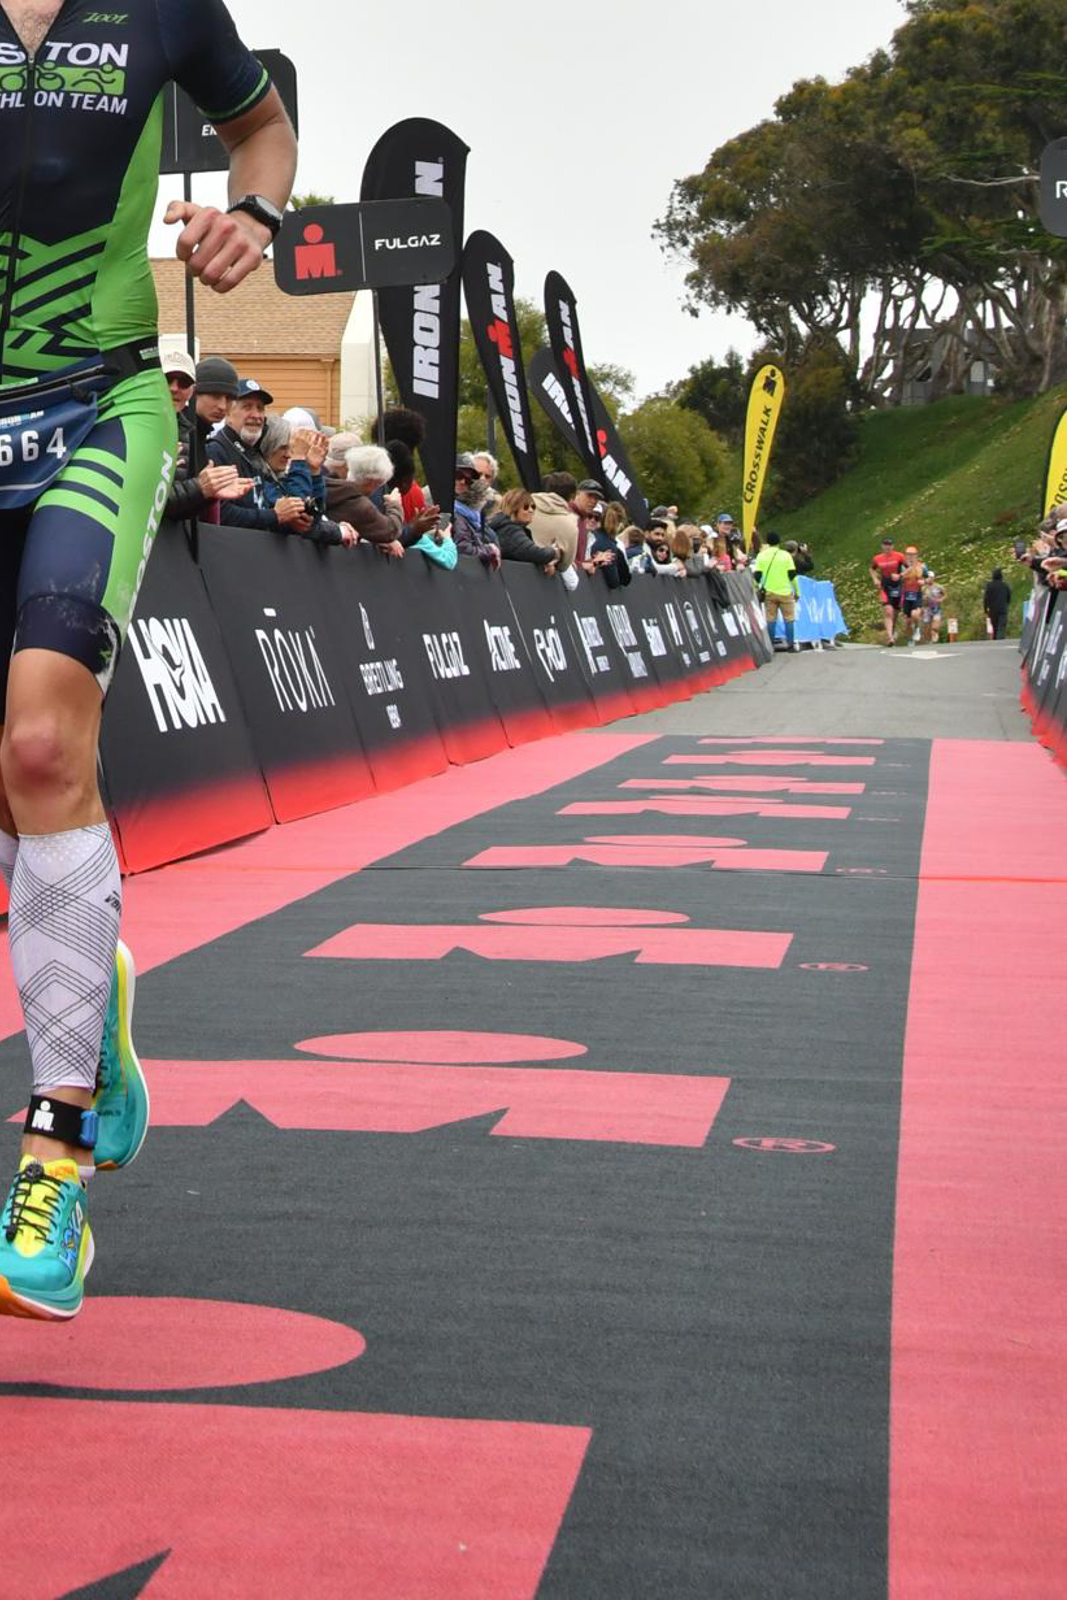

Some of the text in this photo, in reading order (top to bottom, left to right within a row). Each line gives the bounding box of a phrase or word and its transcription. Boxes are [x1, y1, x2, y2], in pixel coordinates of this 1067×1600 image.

[69, 91, 129, 116] TEAM
[374, 233, 442, 251] FULGAZ
[486, 261, 528, 455] IRONMAN
[743, 404, 772, 504] CROSSWALK
[127, 616, 226, 733] HOKA
